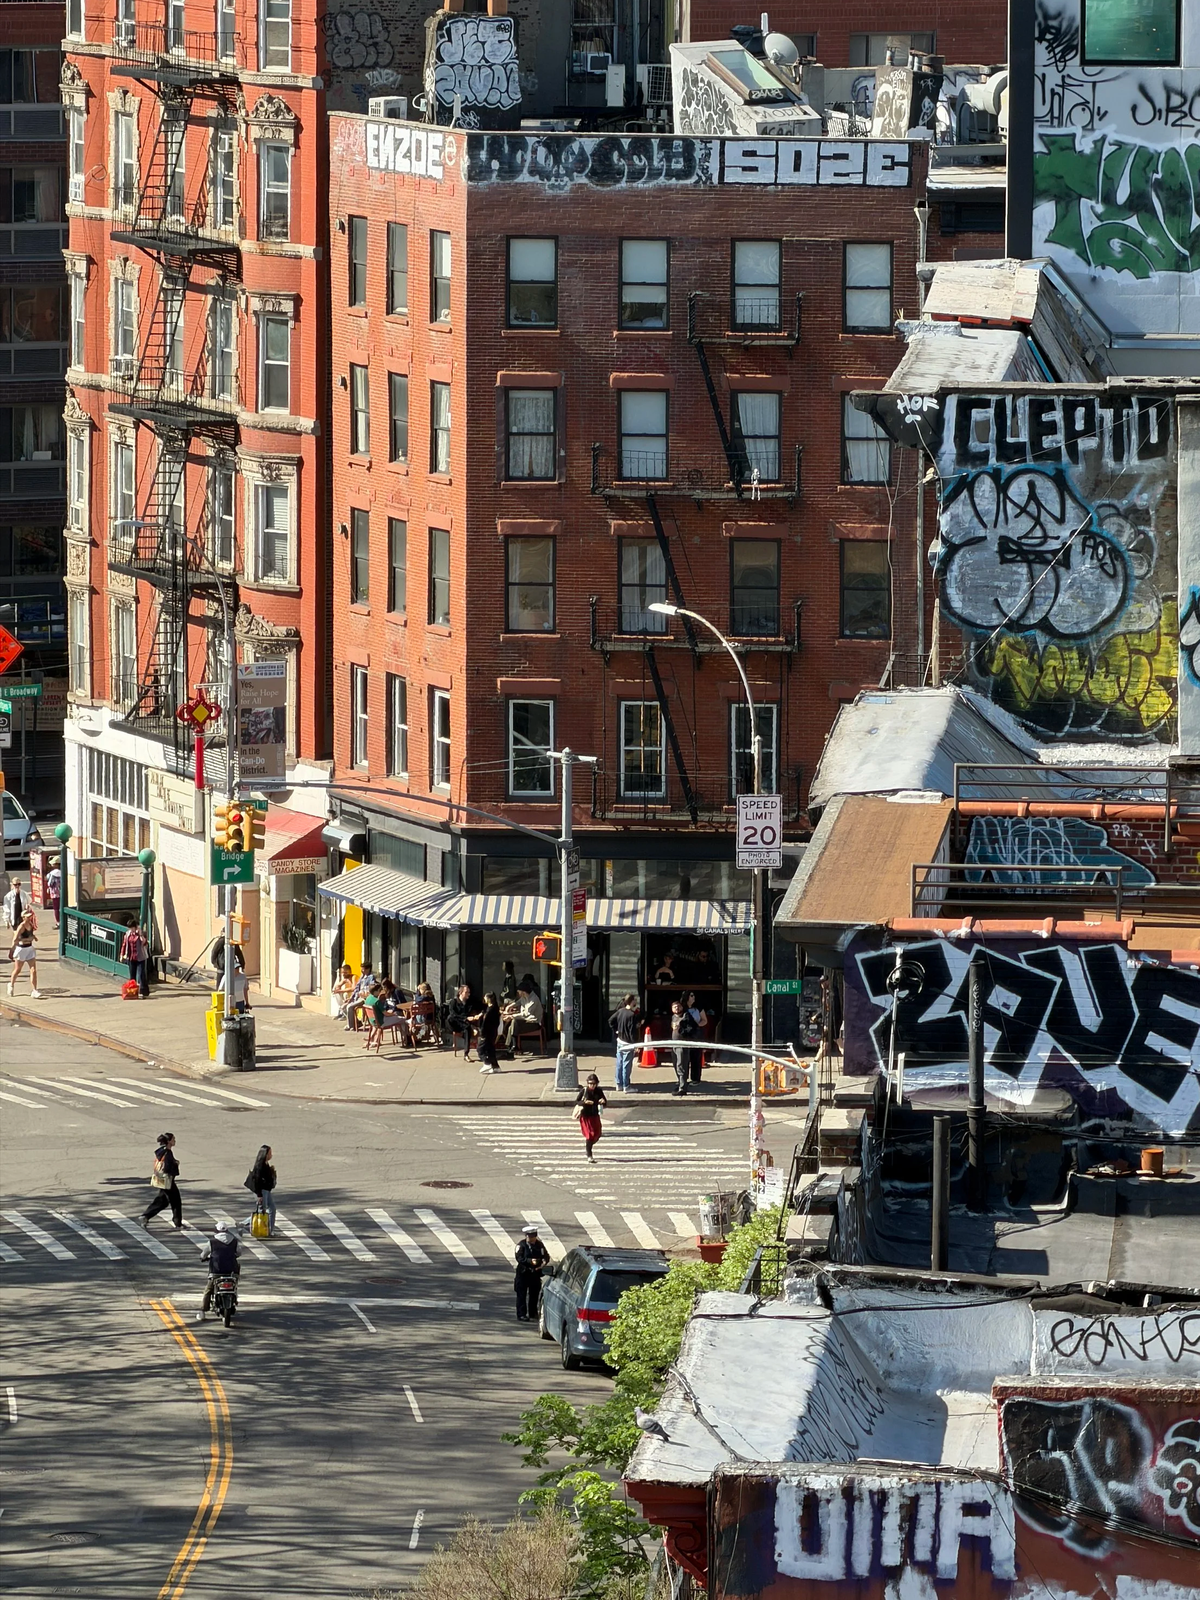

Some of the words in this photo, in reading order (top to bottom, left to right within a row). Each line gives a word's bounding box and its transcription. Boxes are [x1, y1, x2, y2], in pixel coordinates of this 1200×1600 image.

[240, 680, 255, 689] Yes,
[9, 686, 38, 697] Broadway
[240, 689, 258, 697] Raise
[260, 688, 279, 697] Hope
[240, 748, 247, 756] In
[248, 747, 260, 755] the
[240, 756, 265, 764] Can-Do
[240, 765, 268, 775] District.
[741, 800, 778, 810] SPEED
[745, 811, 774, 821] LIMIT
[742, 825, 777, 846] 20
[221, 852, 245, 862] Bridge
[270, 860, 295, 868] CANDY
[298, 858, 321, 866] STORE
[274, 865, 316, 874] MAGAZINES
[767, 981, 789, 993] Canal
[792, 981, 798, 989] St
